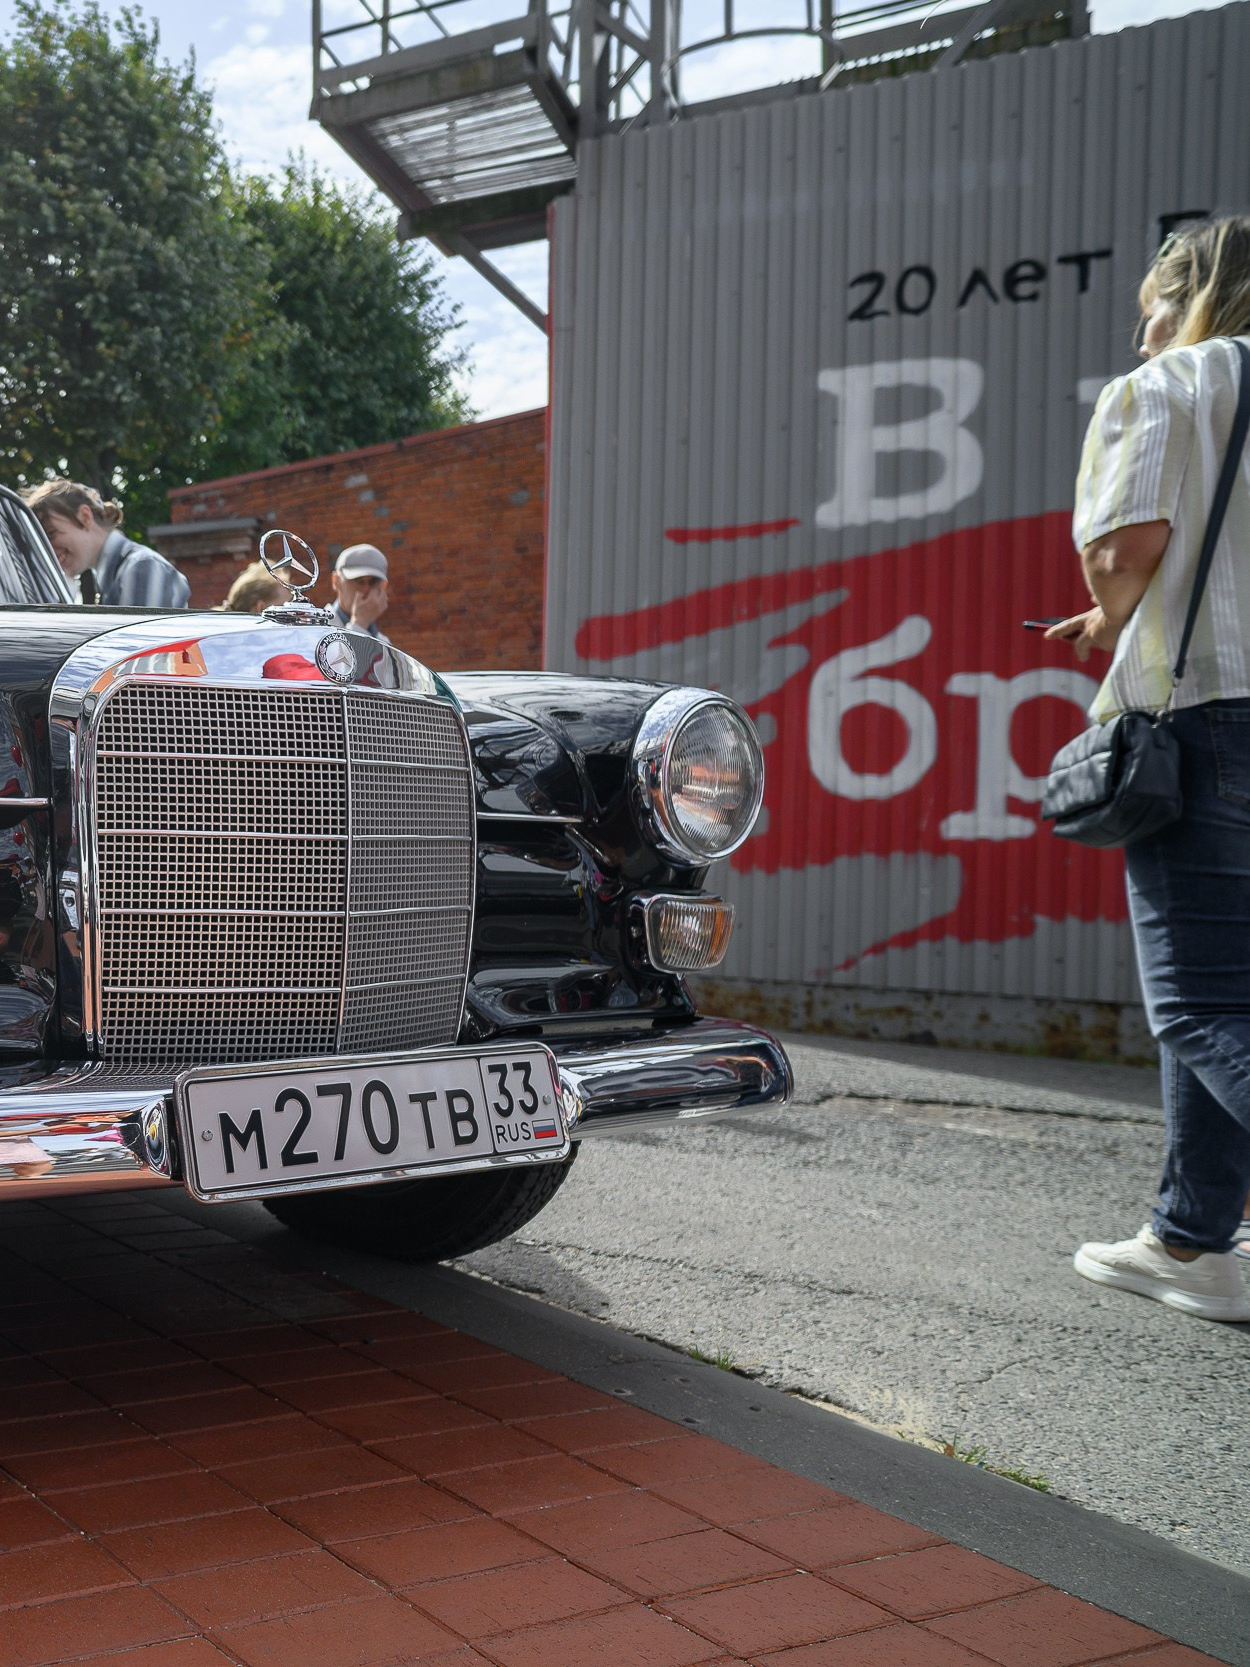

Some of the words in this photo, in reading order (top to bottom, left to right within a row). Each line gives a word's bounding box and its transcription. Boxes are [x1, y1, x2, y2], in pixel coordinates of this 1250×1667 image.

[847, 264, 937, 321] 20
[957, 248, 1112, 309] лет
[816, 358, 985, 529] В
[487, 1061, 540, 1118] 33
[495, 1121, 533, 1144] RUS
